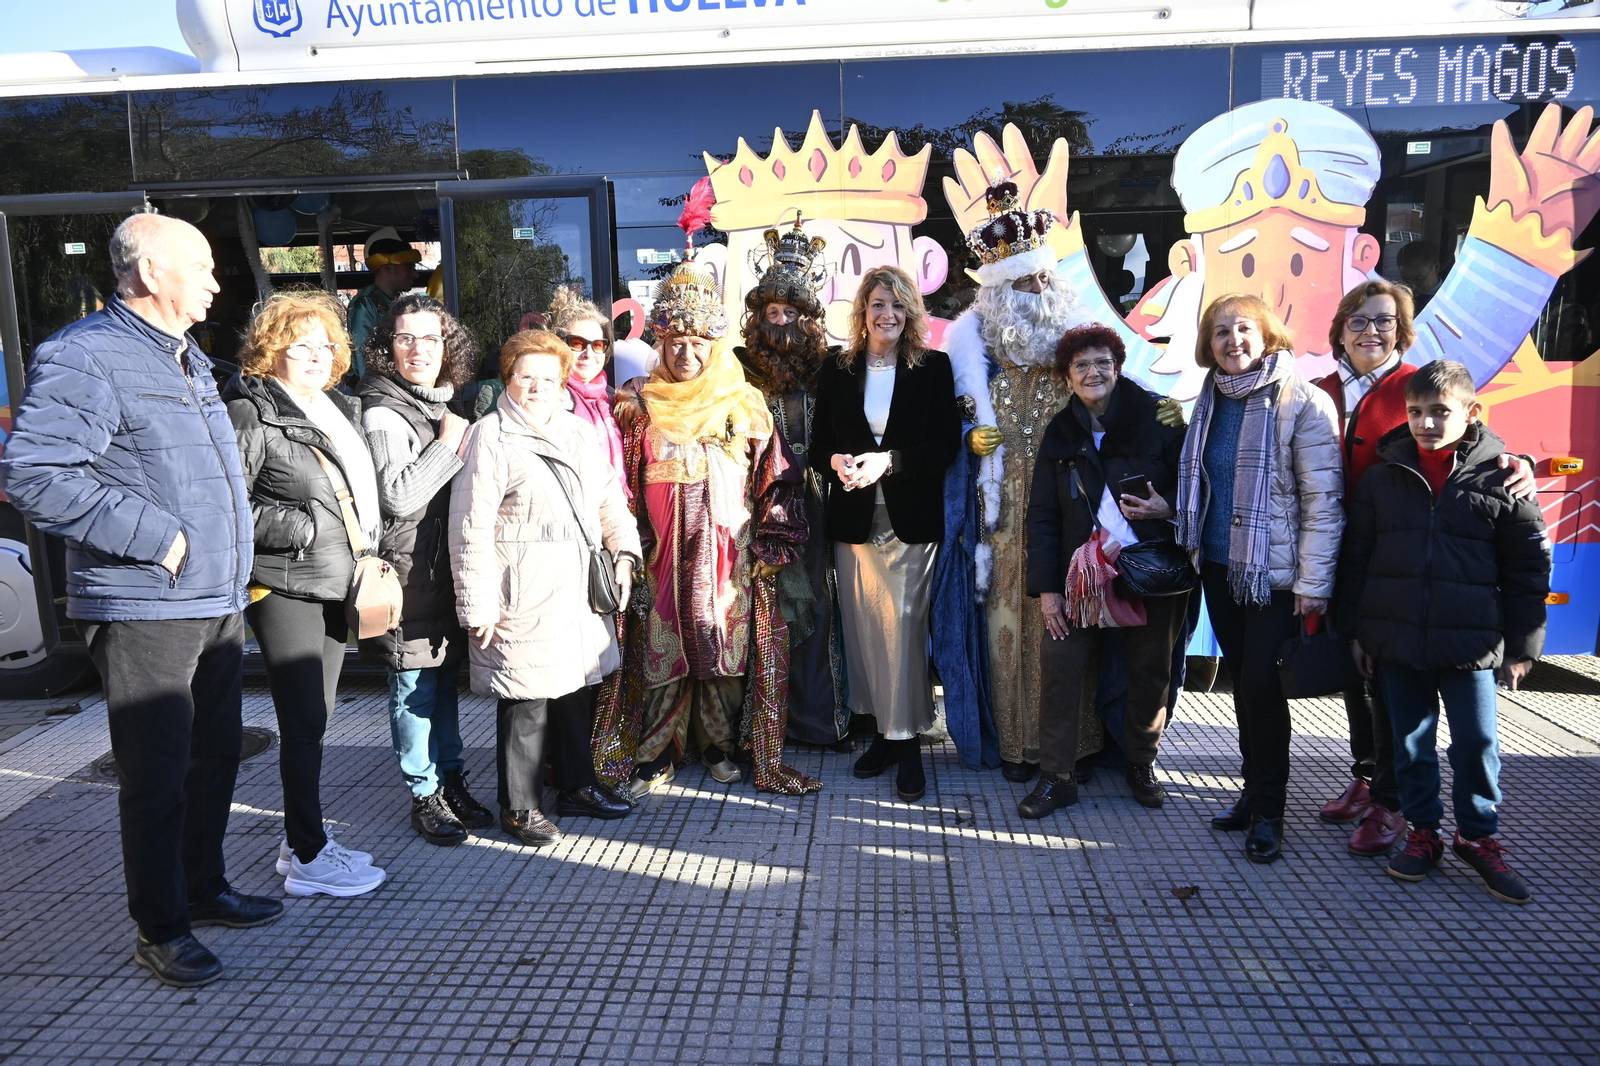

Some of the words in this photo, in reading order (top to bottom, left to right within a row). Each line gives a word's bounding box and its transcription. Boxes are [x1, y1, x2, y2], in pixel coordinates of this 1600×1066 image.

[326, 0, 563, 37] Ayuntamiento
[1283, 48, 1418, 106] REYES
[1437, 41, 1576, 102] MAGOS
